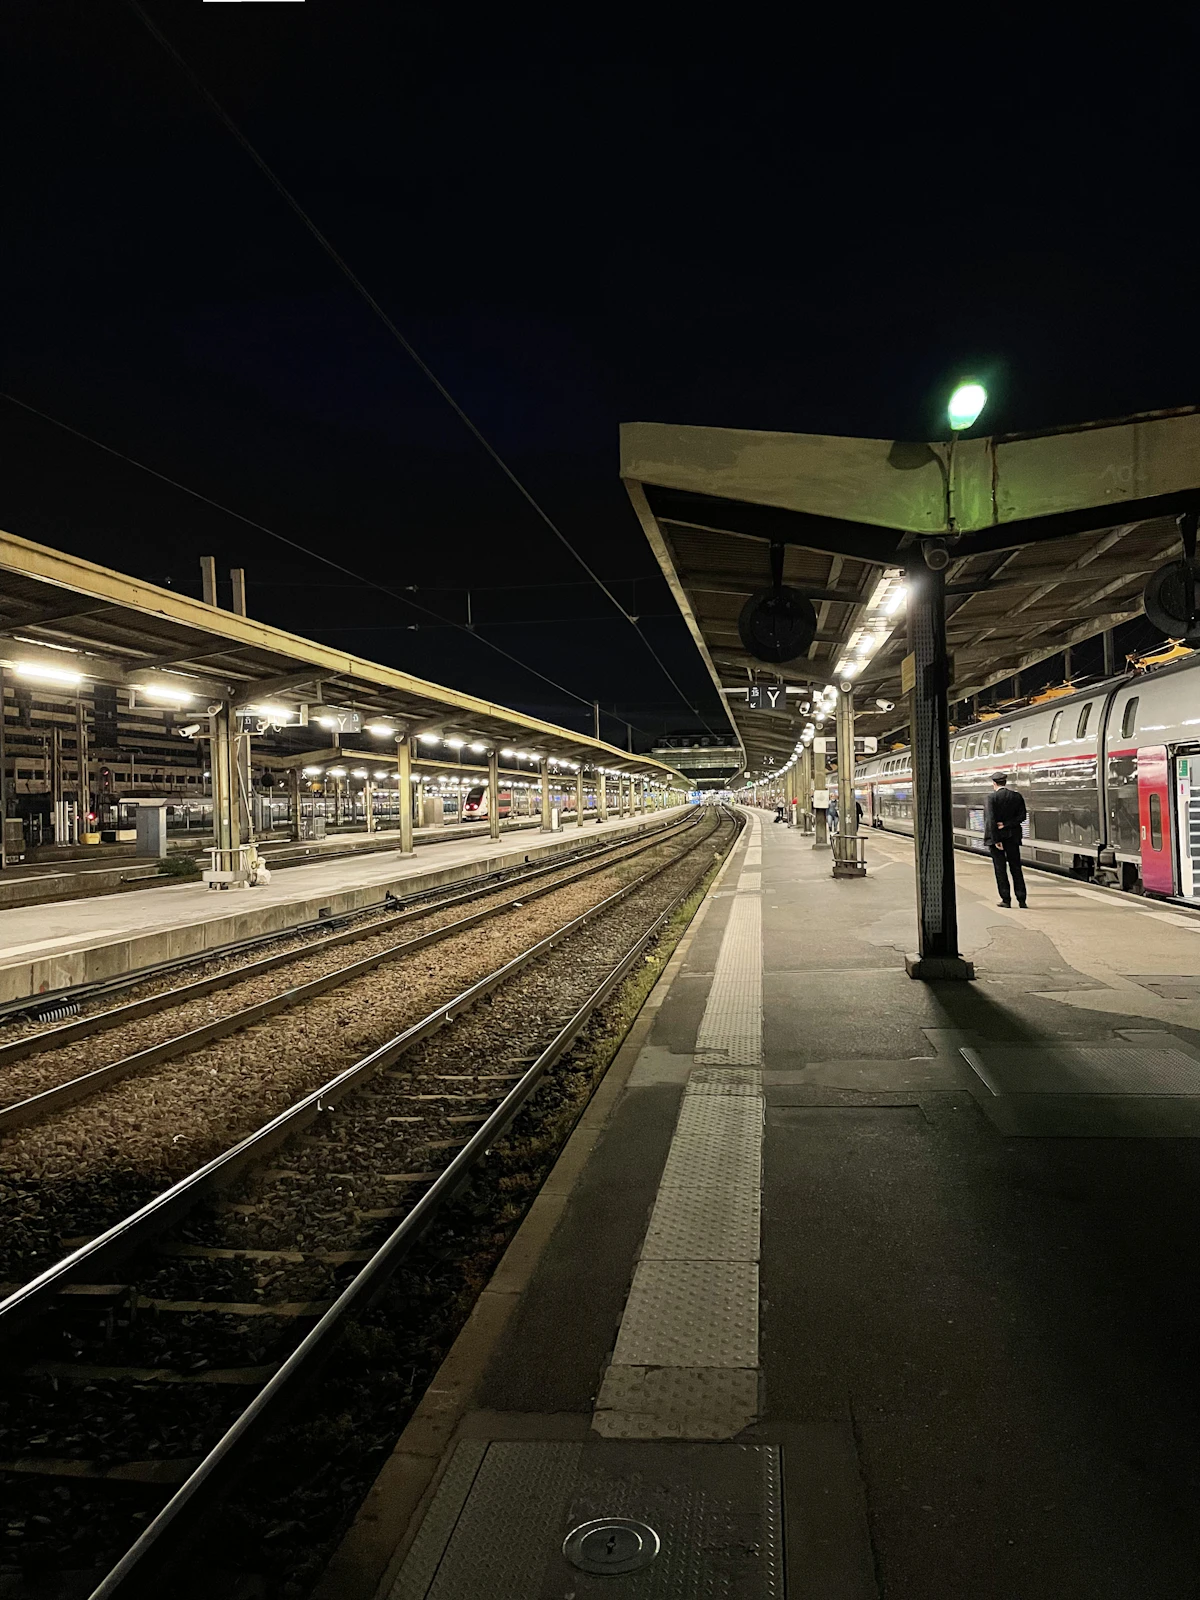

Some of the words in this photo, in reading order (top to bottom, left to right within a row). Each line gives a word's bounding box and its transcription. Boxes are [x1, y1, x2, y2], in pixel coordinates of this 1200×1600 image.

[766, 690, 780, 708] Y
[336, 717, 347, 732] Y
[552, 766, 558, 774] X
[302, 772, 308, 780] X
